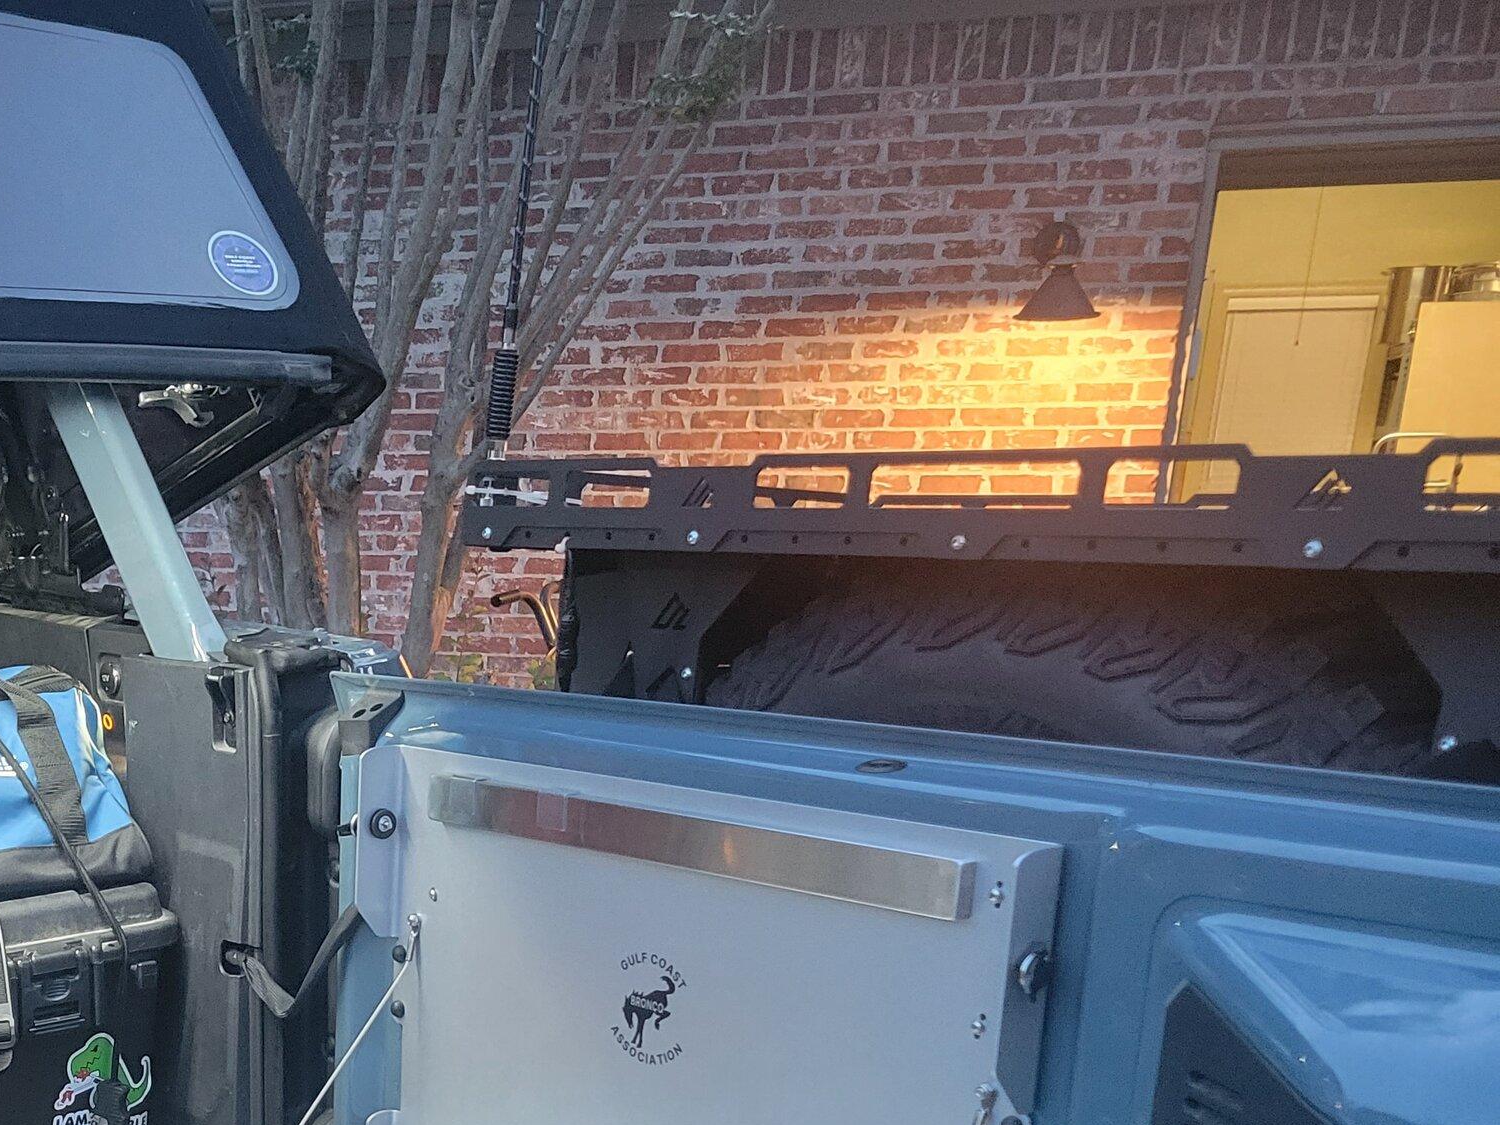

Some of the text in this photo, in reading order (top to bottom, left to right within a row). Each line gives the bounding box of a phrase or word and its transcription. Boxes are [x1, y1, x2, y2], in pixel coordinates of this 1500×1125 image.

[620, 952, 687, 989] GULF COAST
[630, 994, 664, 1013] BRONCO
[610, 1026, 683, 1066] ASSOCIATION
